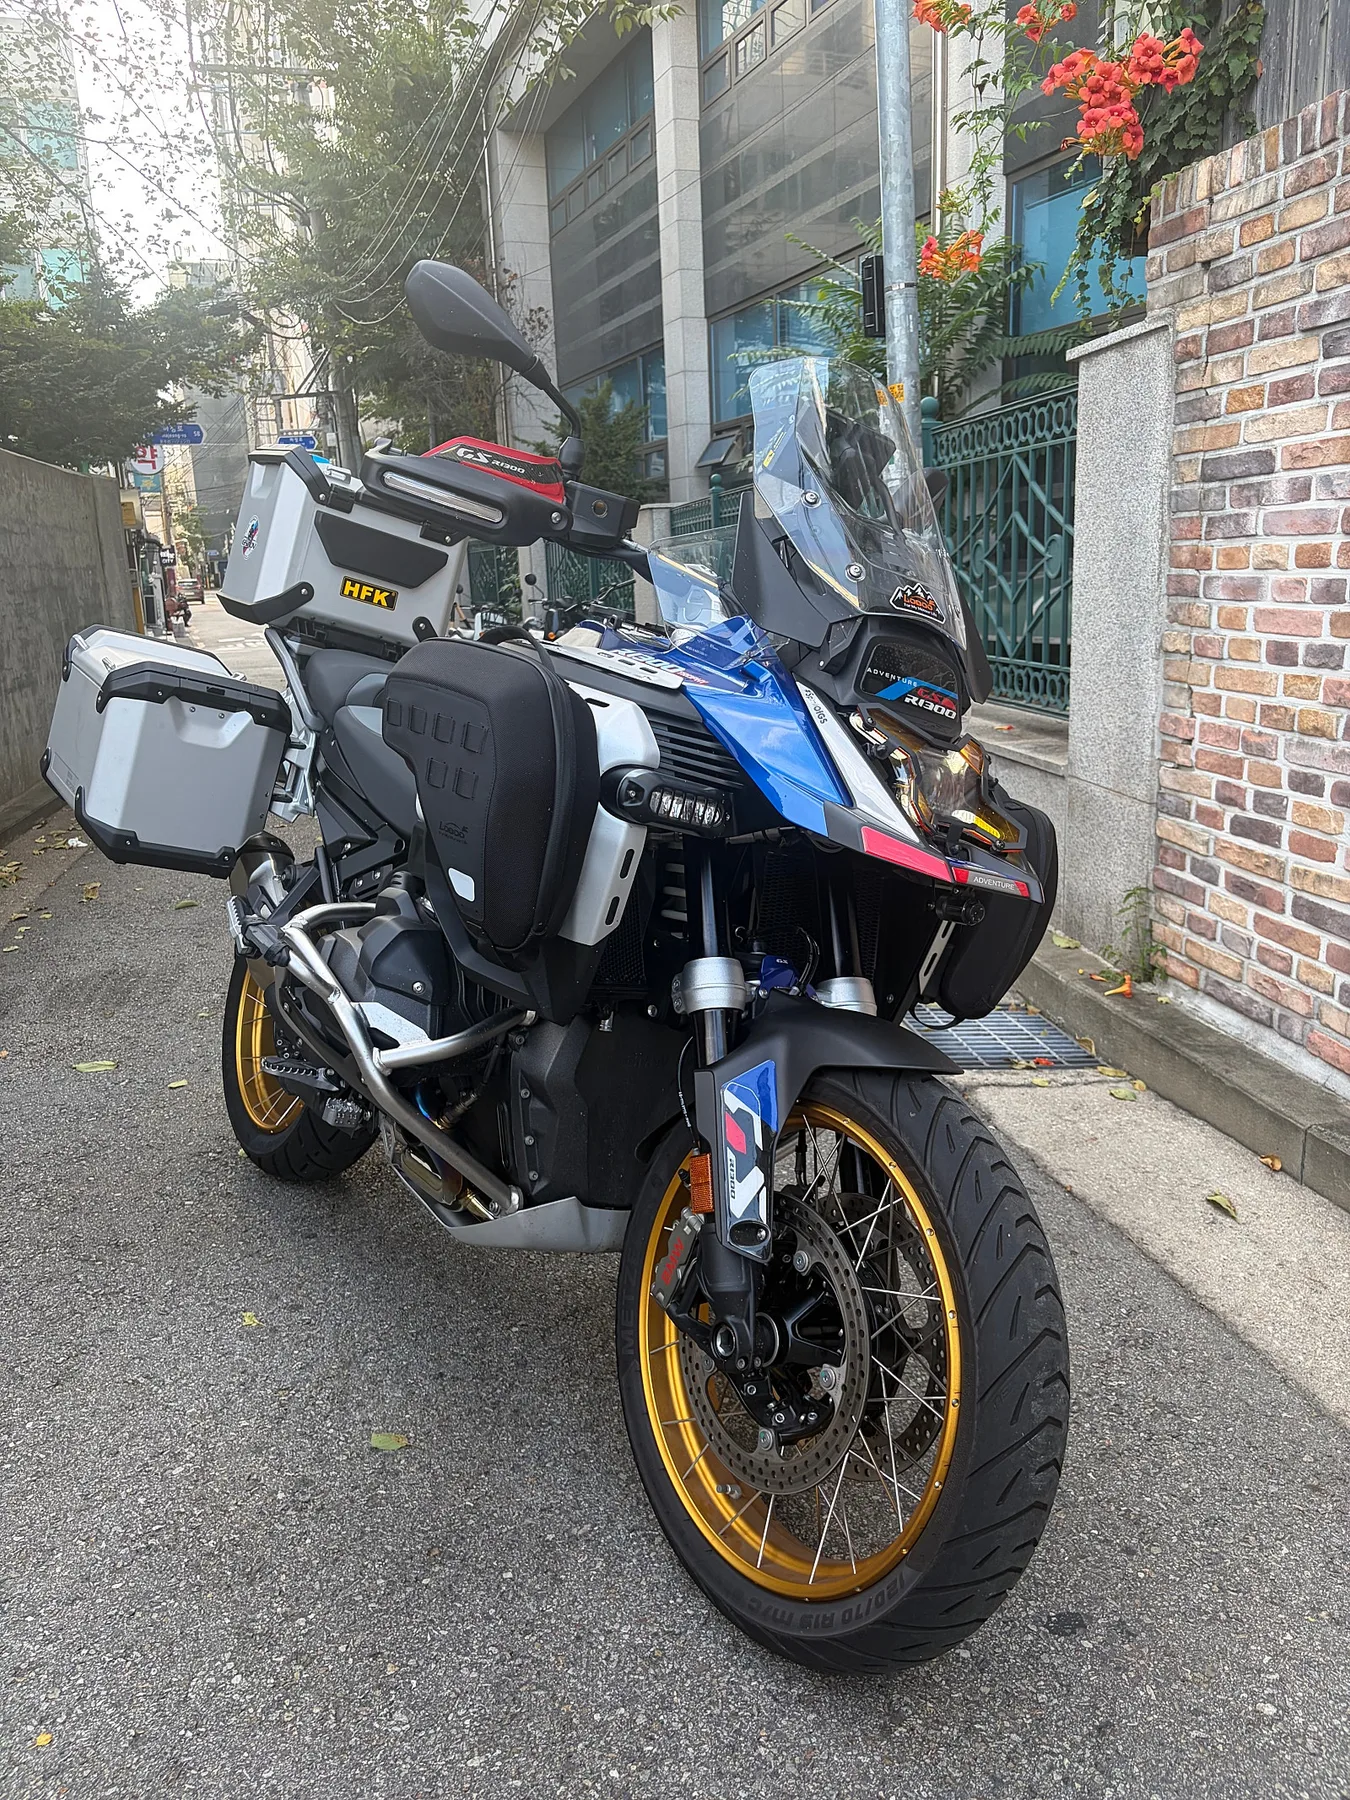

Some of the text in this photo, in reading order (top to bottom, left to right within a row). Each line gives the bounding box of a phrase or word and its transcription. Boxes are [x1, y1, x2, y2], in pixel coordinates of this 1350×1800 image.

[135, 446, 158, 470] 약
[456, 447, 526, 474] GS R1300
[343, 580, 390, 607] HFK
[866, 667, 918, 687] ADVENTURE
[903, 693, 957, 720] R1300
[973, 876, 1015, 891] ADVENTURE
[661, 1236, 685, 1286] BMW
[842, 1571, 905, 1625] 120/70
